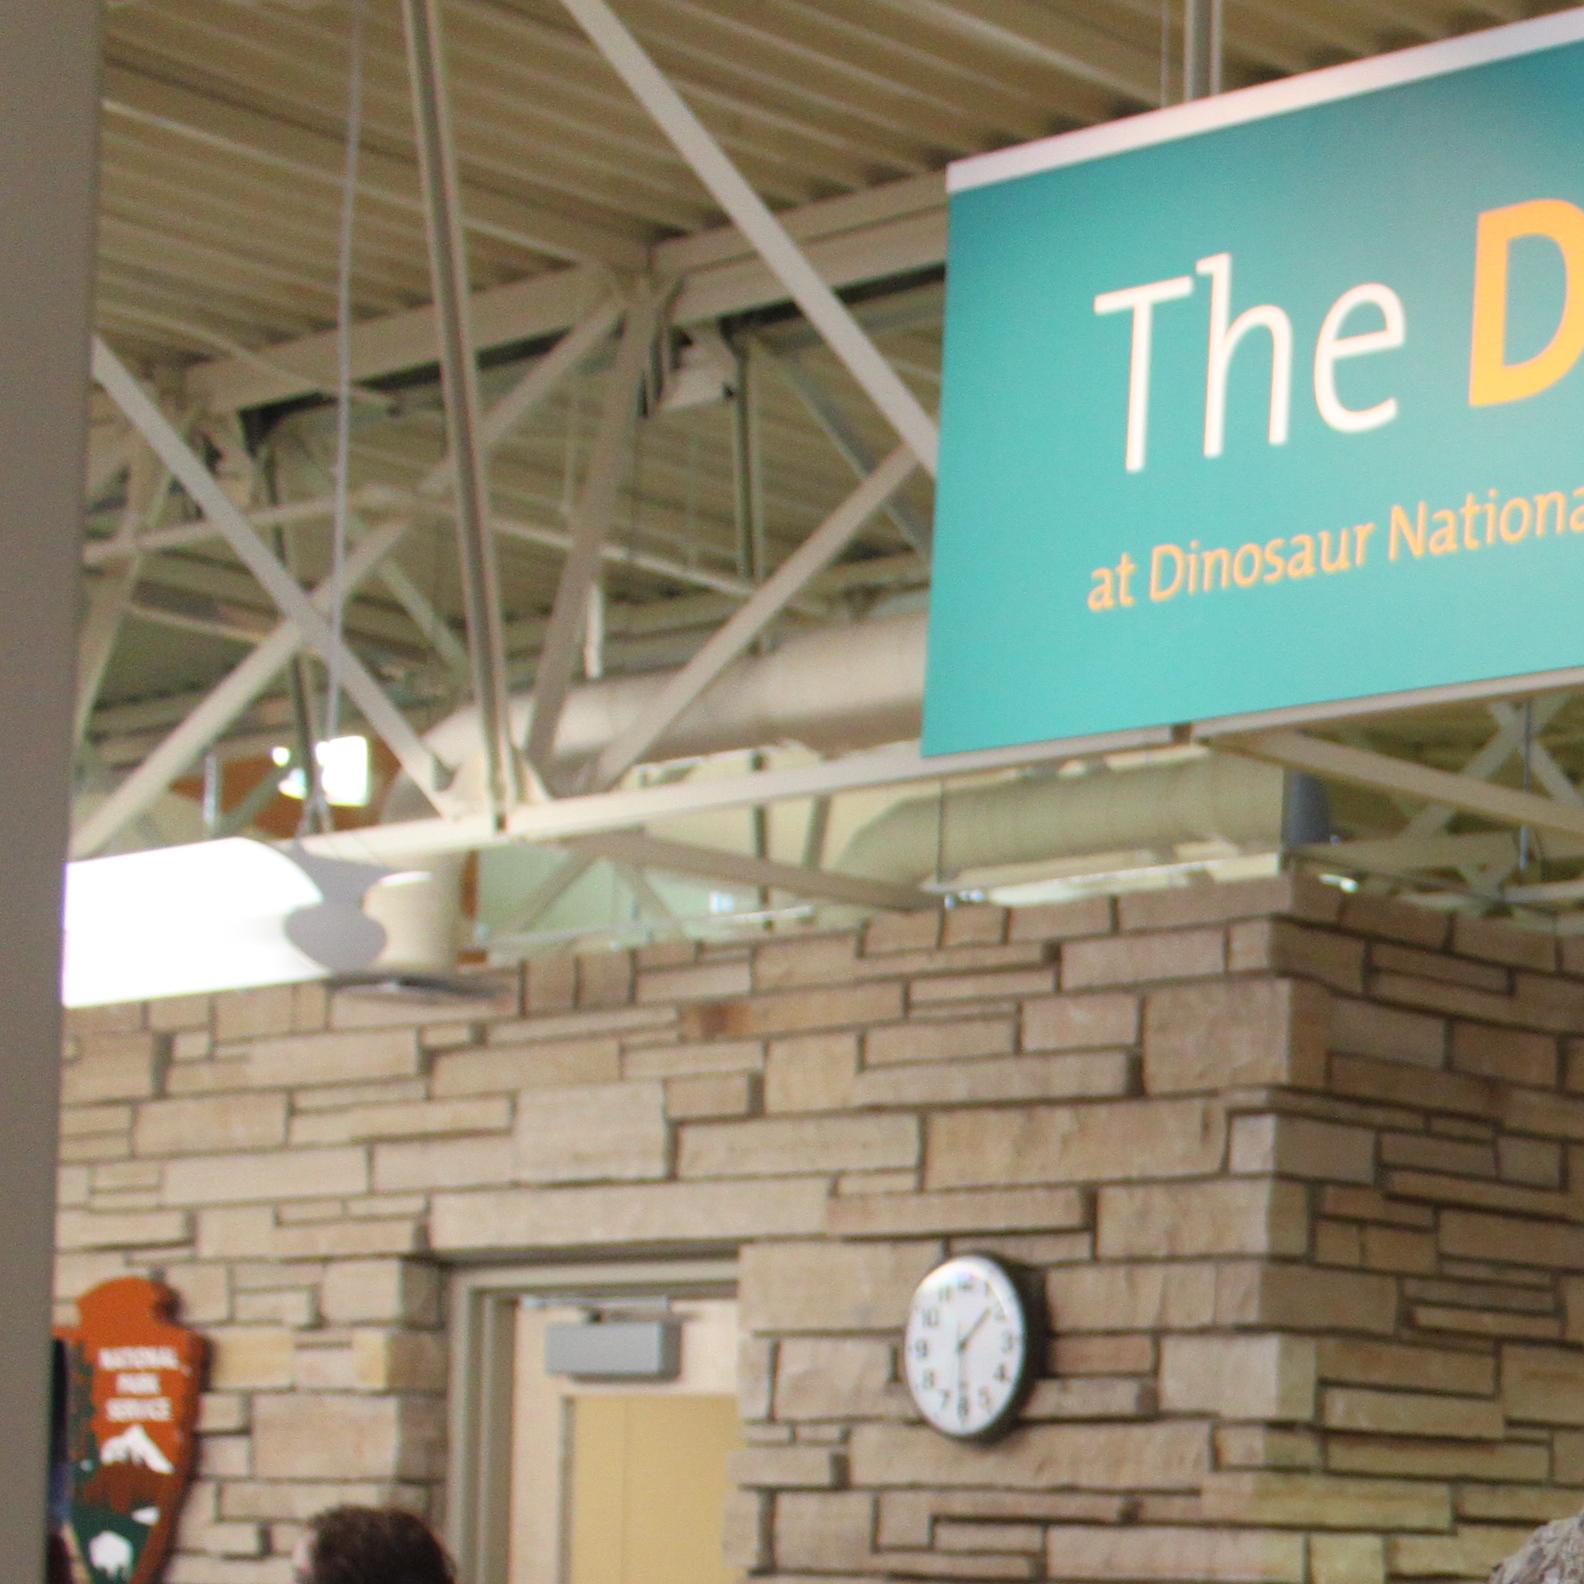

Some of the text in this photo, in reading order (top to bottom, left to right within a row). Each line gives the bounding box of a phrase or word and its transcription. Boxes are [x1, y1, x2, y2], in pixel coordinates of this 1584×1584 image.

[1093, 251, 1406, 473] The
[1086, 553, 1135, 613] at
[1147, 517, 1374, 605] Dinosaur
